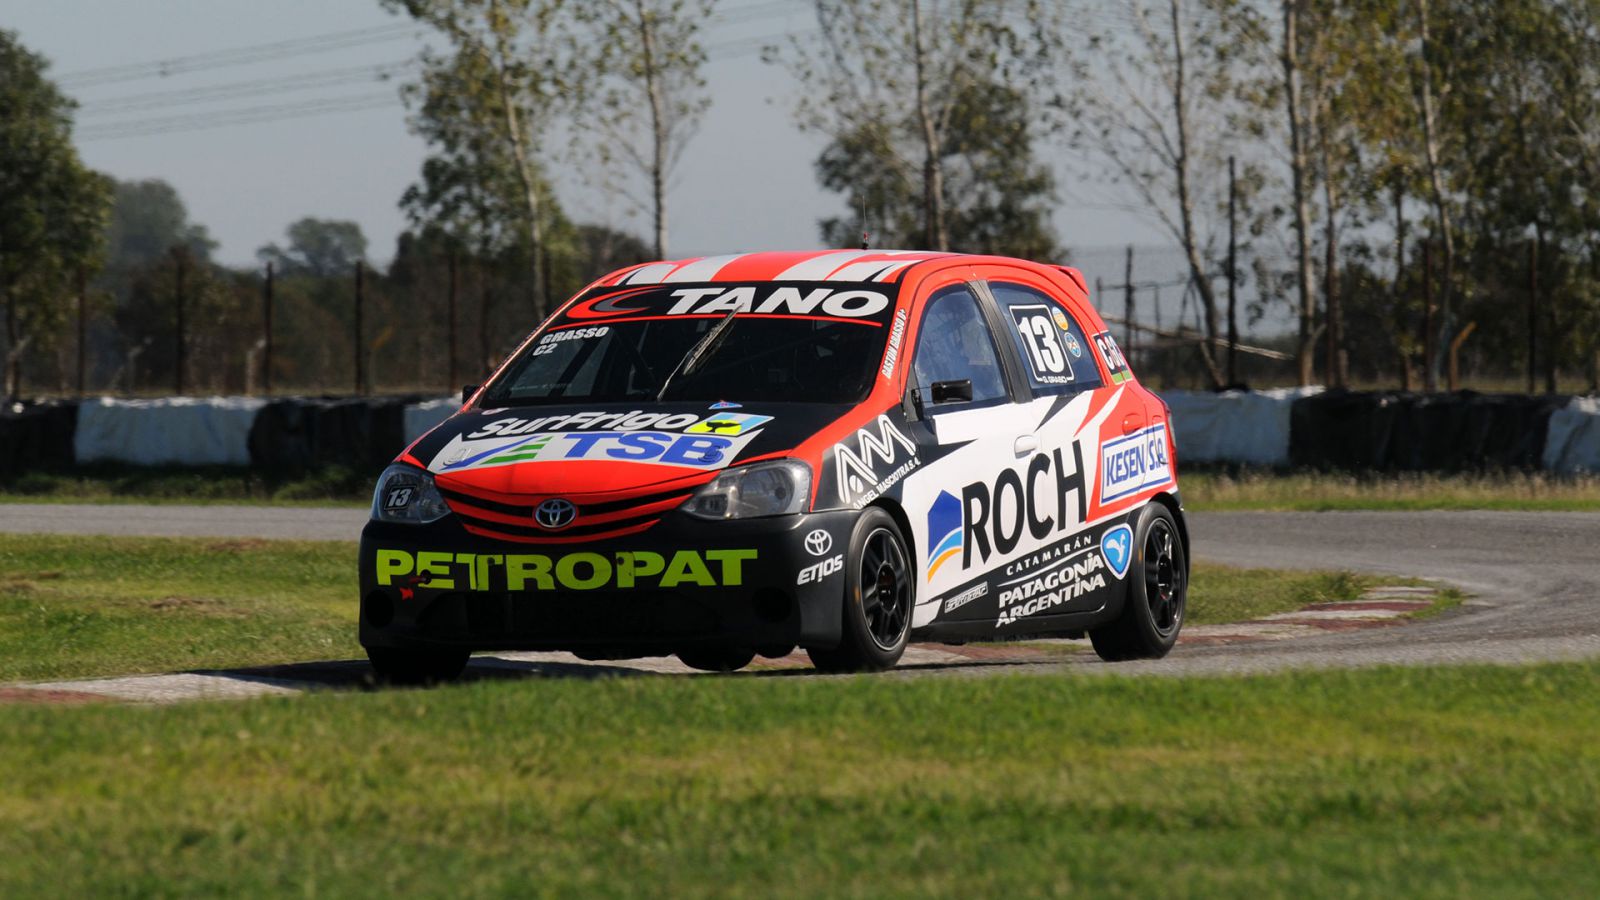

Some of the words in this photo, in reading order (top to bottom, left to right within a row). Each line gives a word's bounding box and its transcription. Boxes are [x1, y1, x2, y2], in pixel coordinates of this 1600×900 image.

[532, 343, 558, 356] C2
[539, 326, 610, 345] GRASSO
[1018, 315, 1065, 373] 13
[564, 432, 734, 466] TSB
[1106, 444, 1146, 487] KESEN
[388, 488, 412, 507] 13
[853, 489, 879, 510] ANGEL
[962, 439, 1087, 570] ROCH
[375, 548, 758, 591] PETROPAT
[797, 554, 843, 585] ETIOS
